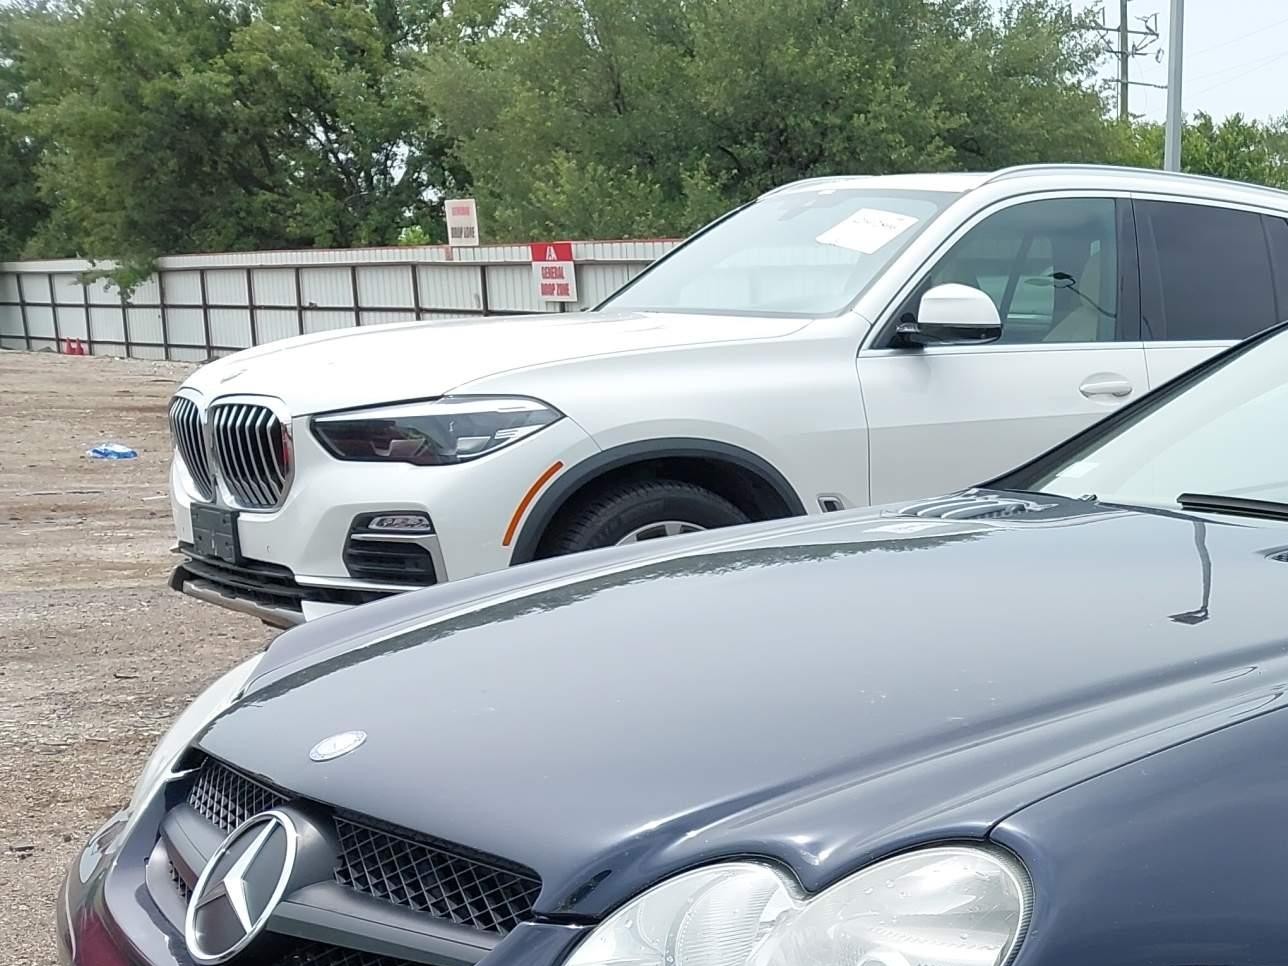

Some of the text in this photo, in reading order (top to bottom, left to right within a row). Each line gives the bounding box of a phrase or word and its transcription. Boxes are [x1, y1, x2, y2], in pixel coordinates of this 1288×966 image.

[541, 266, 564, 279] GENERAL
[540, 282, 570, 296] DROP ZONE
